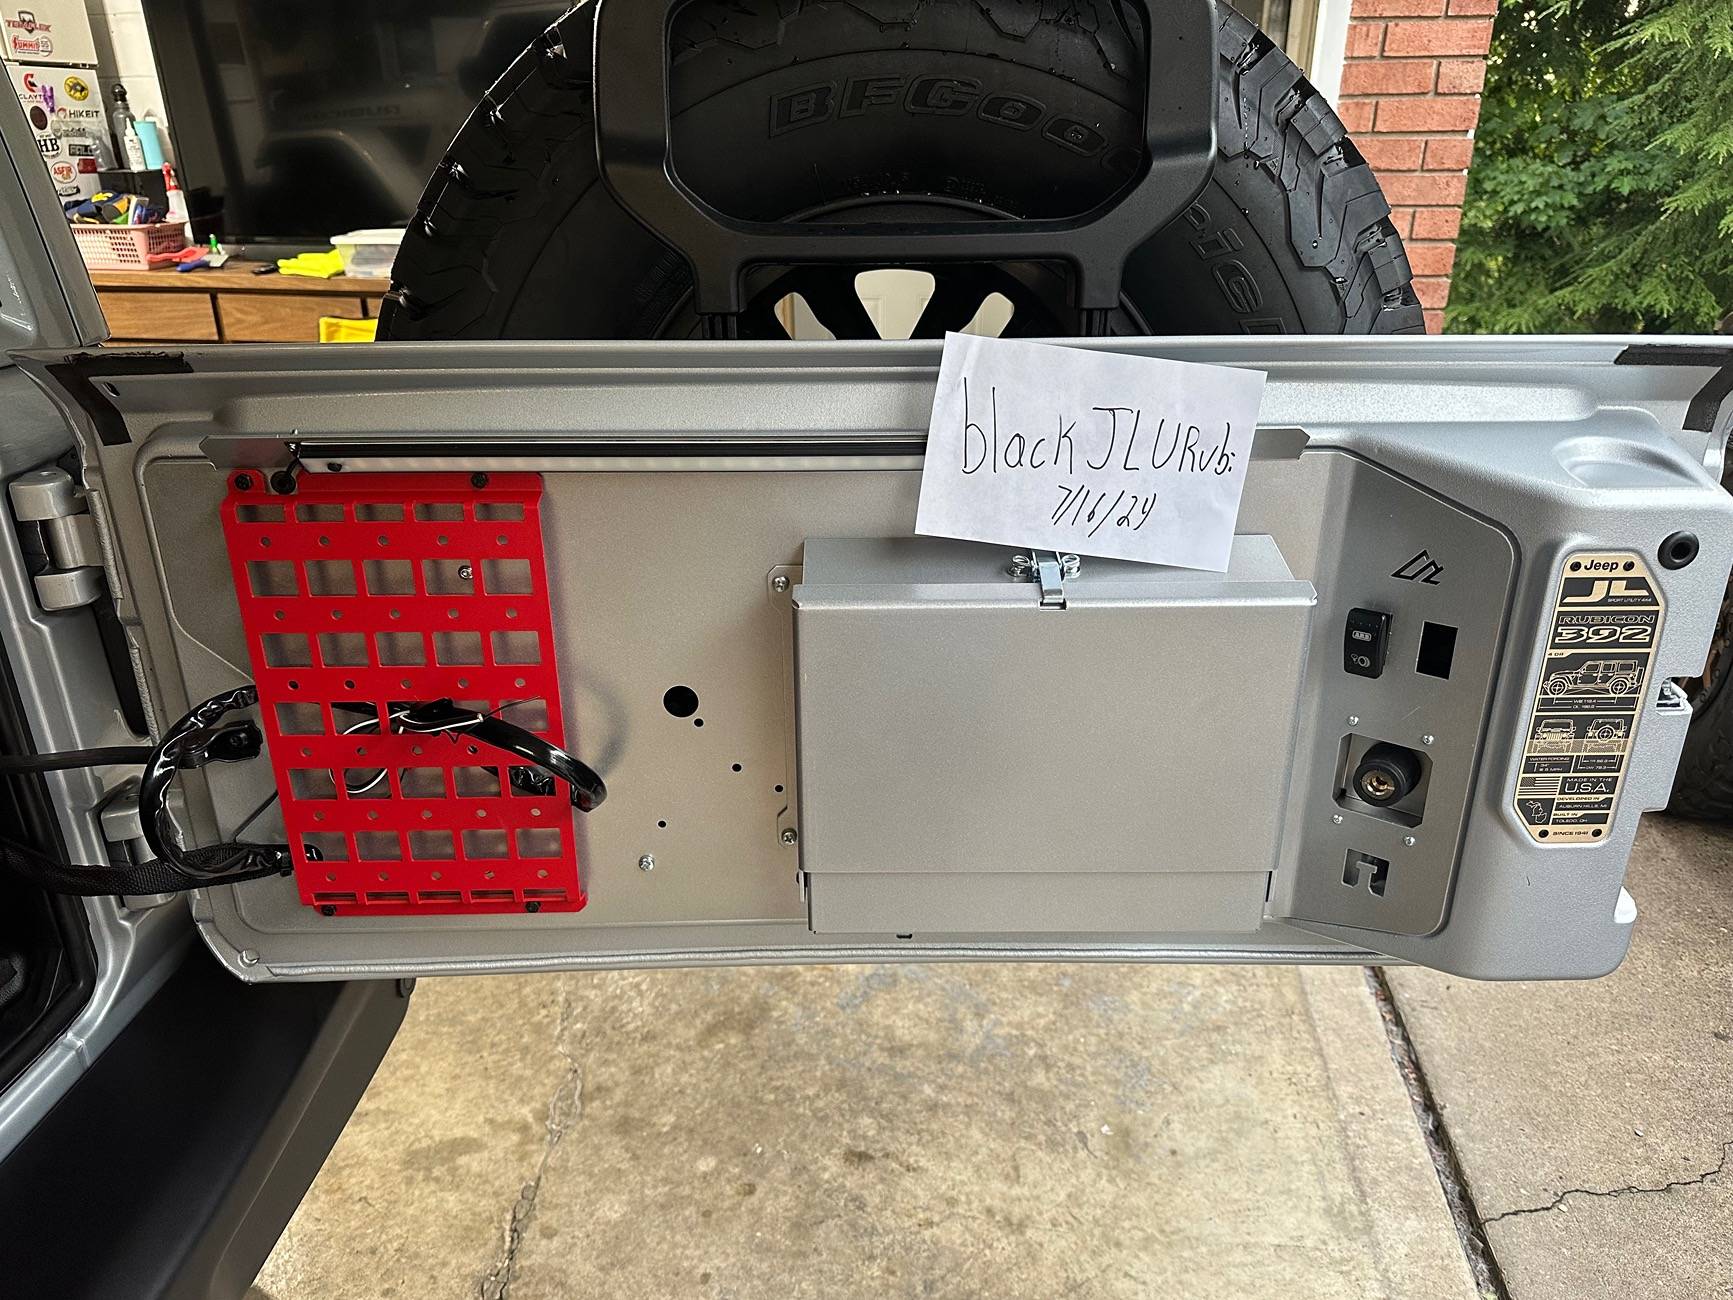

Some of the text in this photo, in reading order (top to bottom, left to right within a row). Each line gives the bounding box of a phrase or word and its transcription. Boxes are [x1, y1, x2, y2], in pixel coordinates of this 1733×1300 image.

[36, 138, 60, 153] HB
[961, 376, 1079, 475] black
[1051, 483, 1157, 538] 7/16/24
[1584, 559, 1619, 572] Jeep
[1561, 580, 1650, 603] JL
[1558, 615, 1656, 624] RUBICON
[1554, 626, 1652, 643] 392
[1564, 782, 1610, 793] U.S.A.
